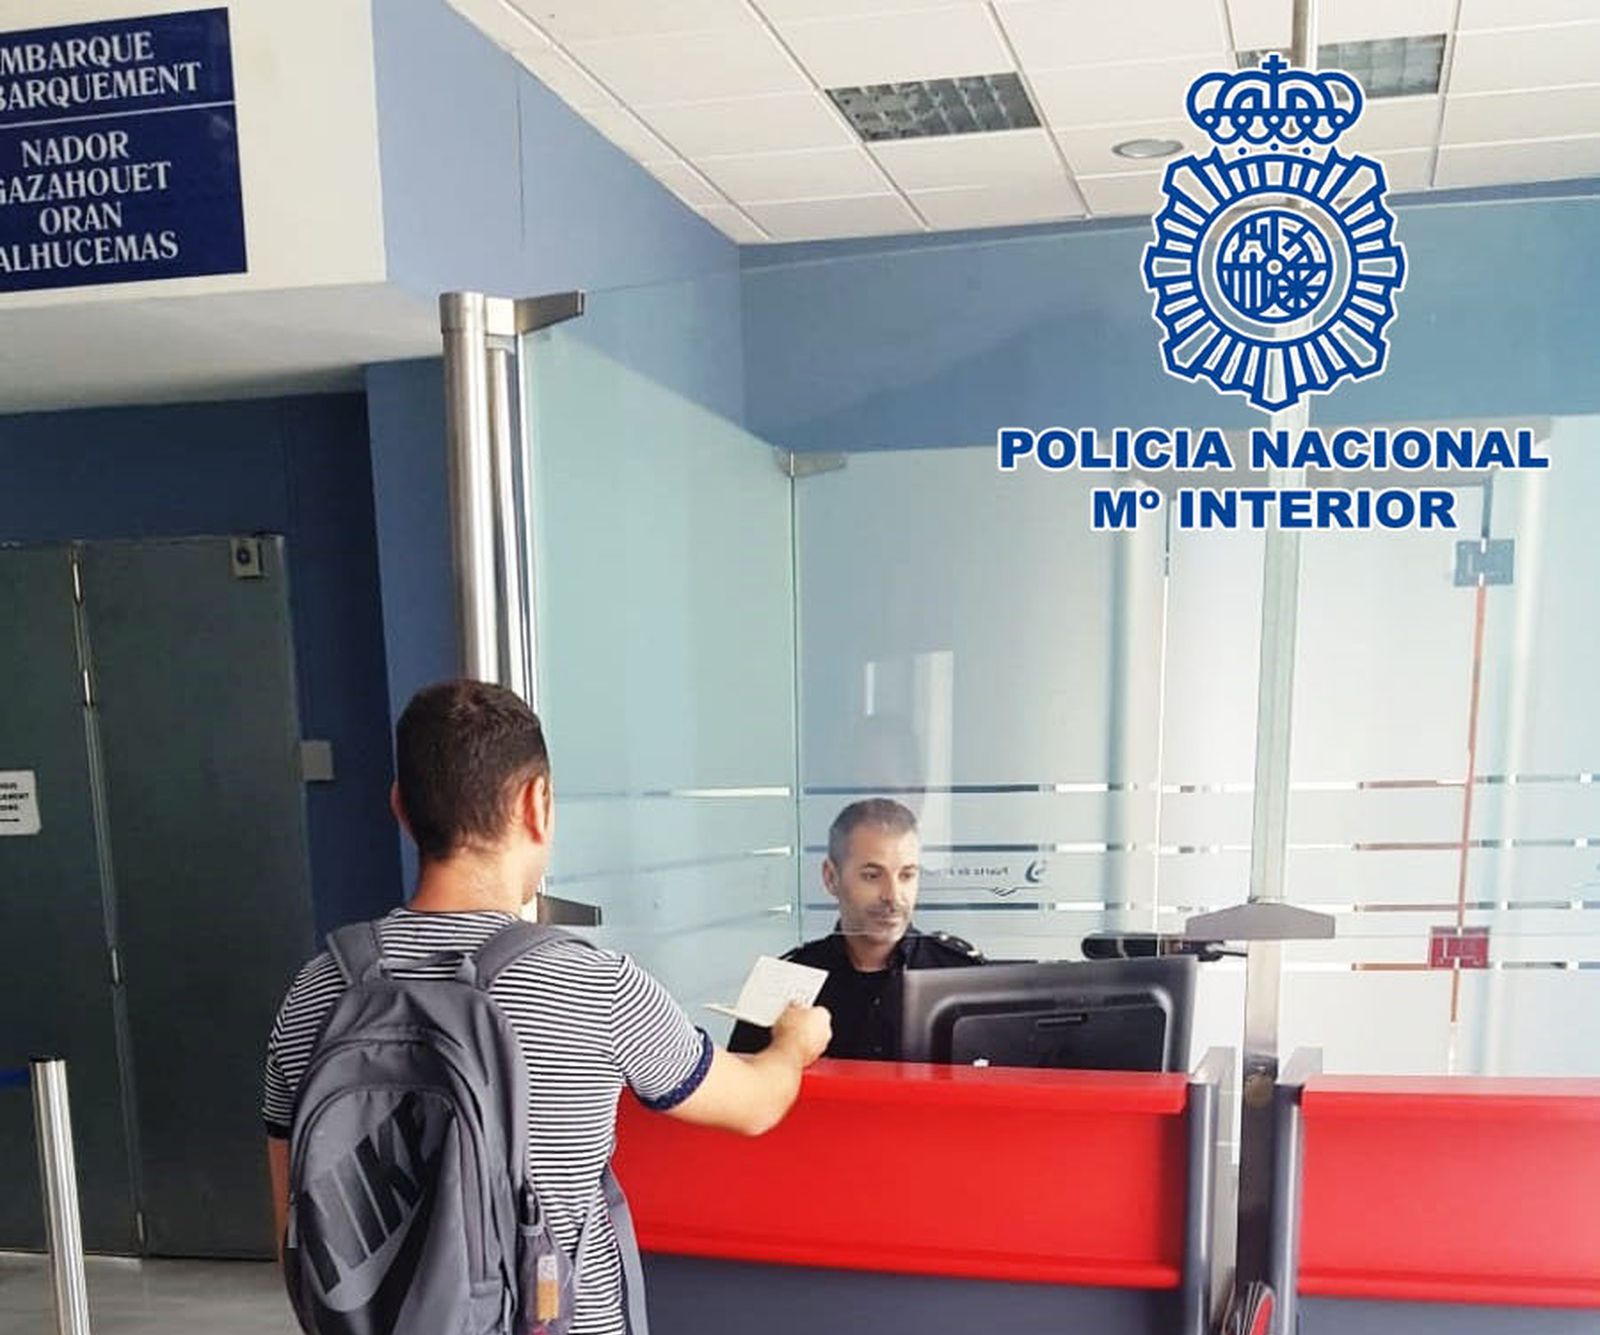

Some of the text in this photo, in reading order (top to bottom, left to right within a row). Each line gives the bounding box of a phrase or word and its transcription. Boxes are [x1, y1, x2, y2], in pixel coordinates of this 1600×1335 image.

[21, 131, 129, 168] NADOR
[39, 202, 122, 235] ORAN
[0, 231, 178, 272] ALHUCEMAS
